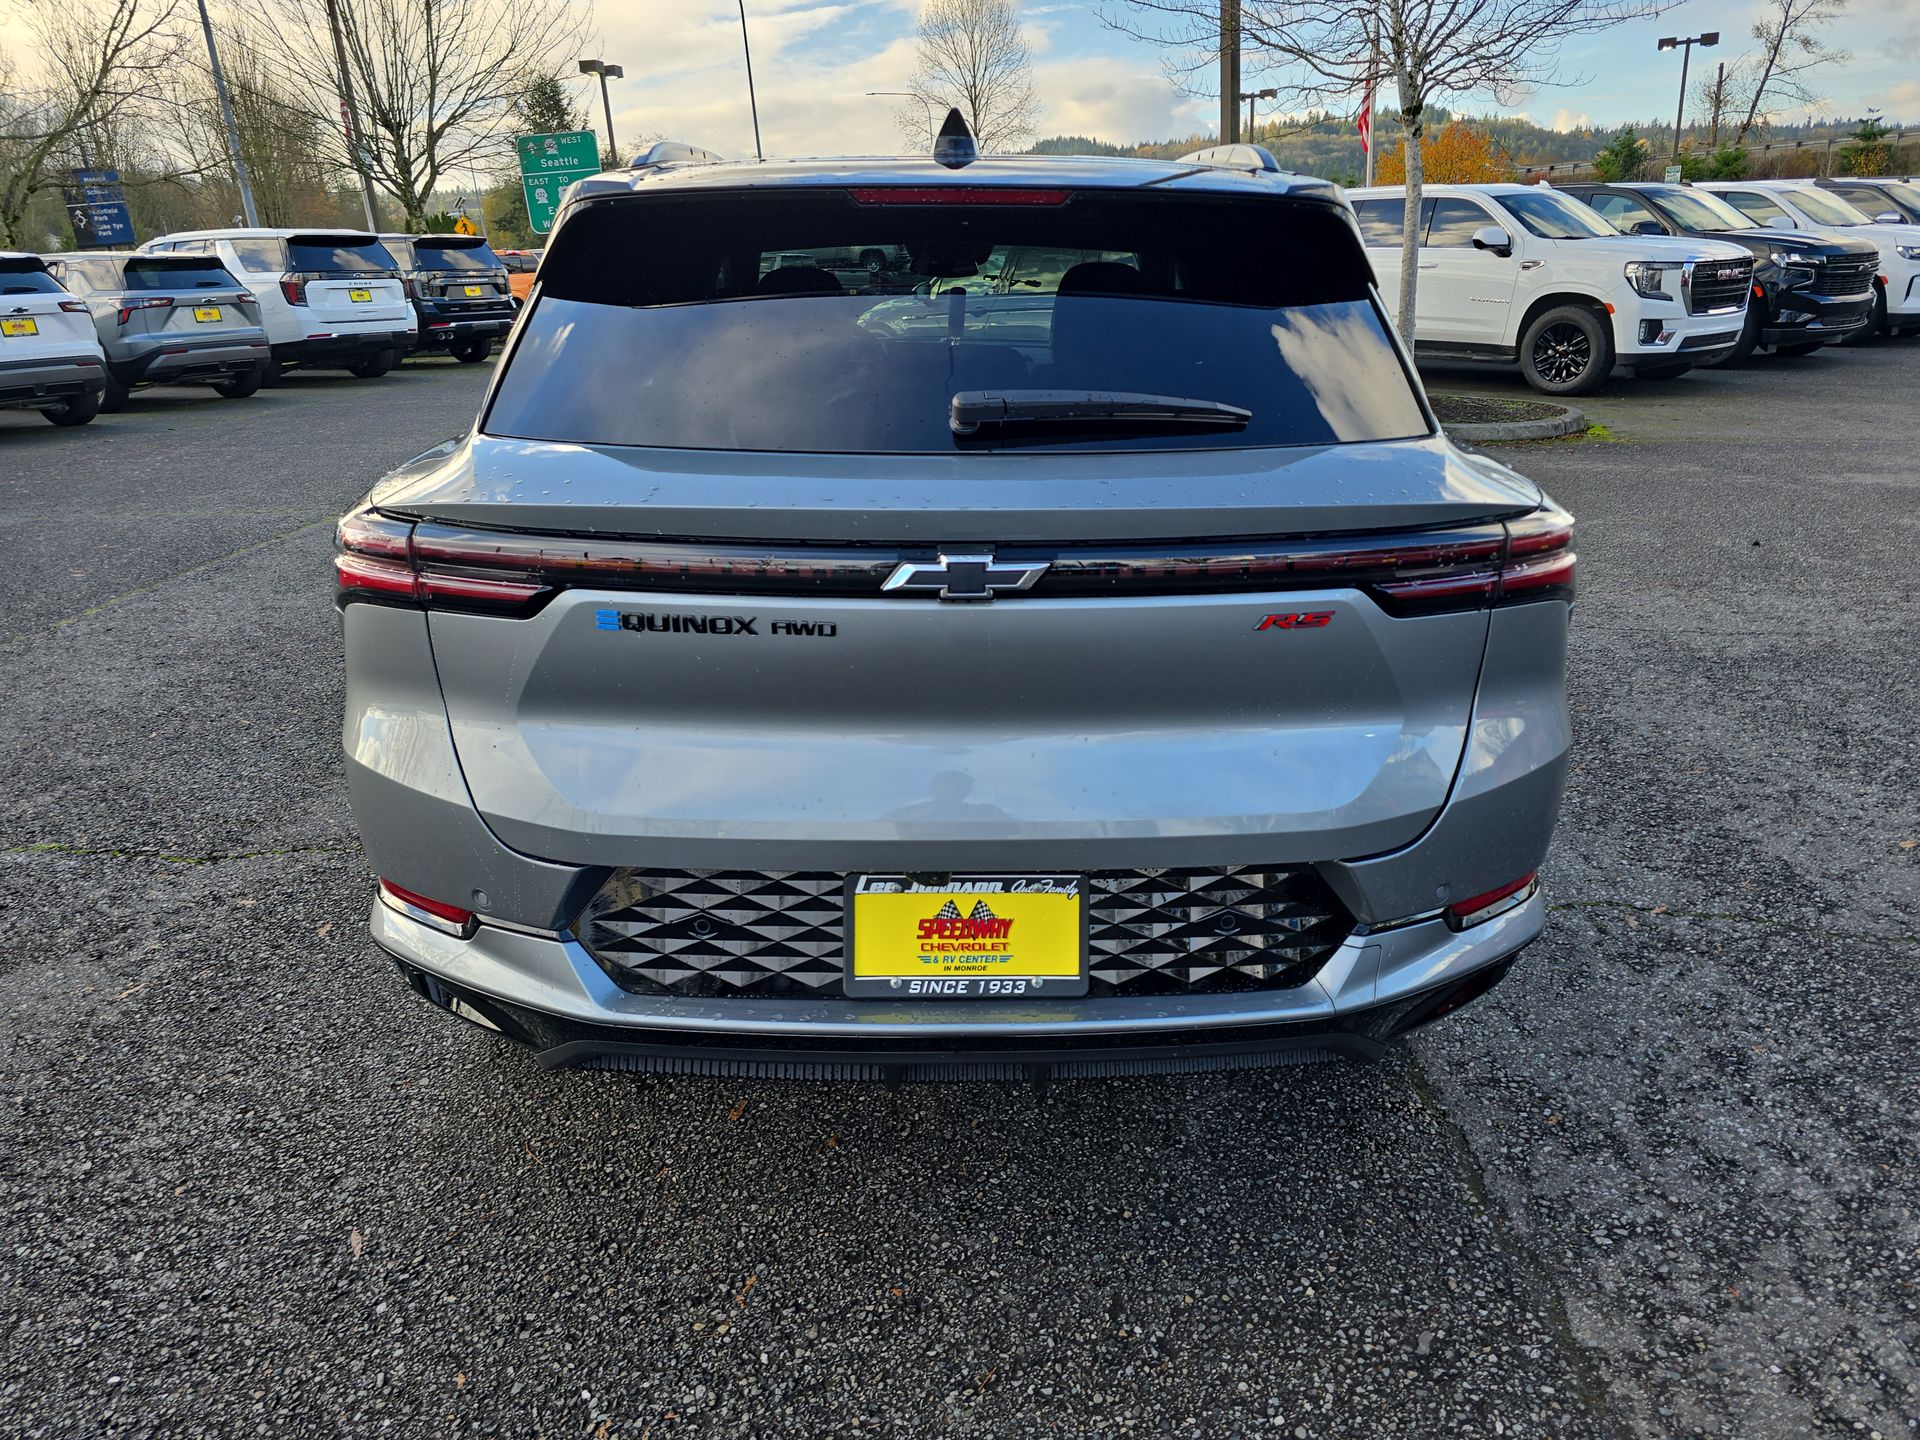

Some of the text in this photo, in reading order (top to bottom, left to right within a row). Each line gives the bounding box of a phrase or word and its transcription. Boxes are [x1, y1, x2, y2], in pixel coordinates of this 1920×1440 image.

[560, 136, 581, 144] WEST
[540, 157, 579, 168] Seattle
[529, 178, 549, 186] EAST
[1717, 268, 1744, 280] GMC
[595, 609, 837, 637] EQUINOX AWD
[1252, 611, 1336, 630] RS
[1011, 879, 1040, 894] Aut
[1041, 879, 1079, 900] Family
[916, 918, 1015, 940] SPEEDWAY
[920, 942, 1010, 952] CHEVROLET
[933, 955, 998, 964] & RV CENTER
[908, 980, 1027, 994] SINCE 1933
